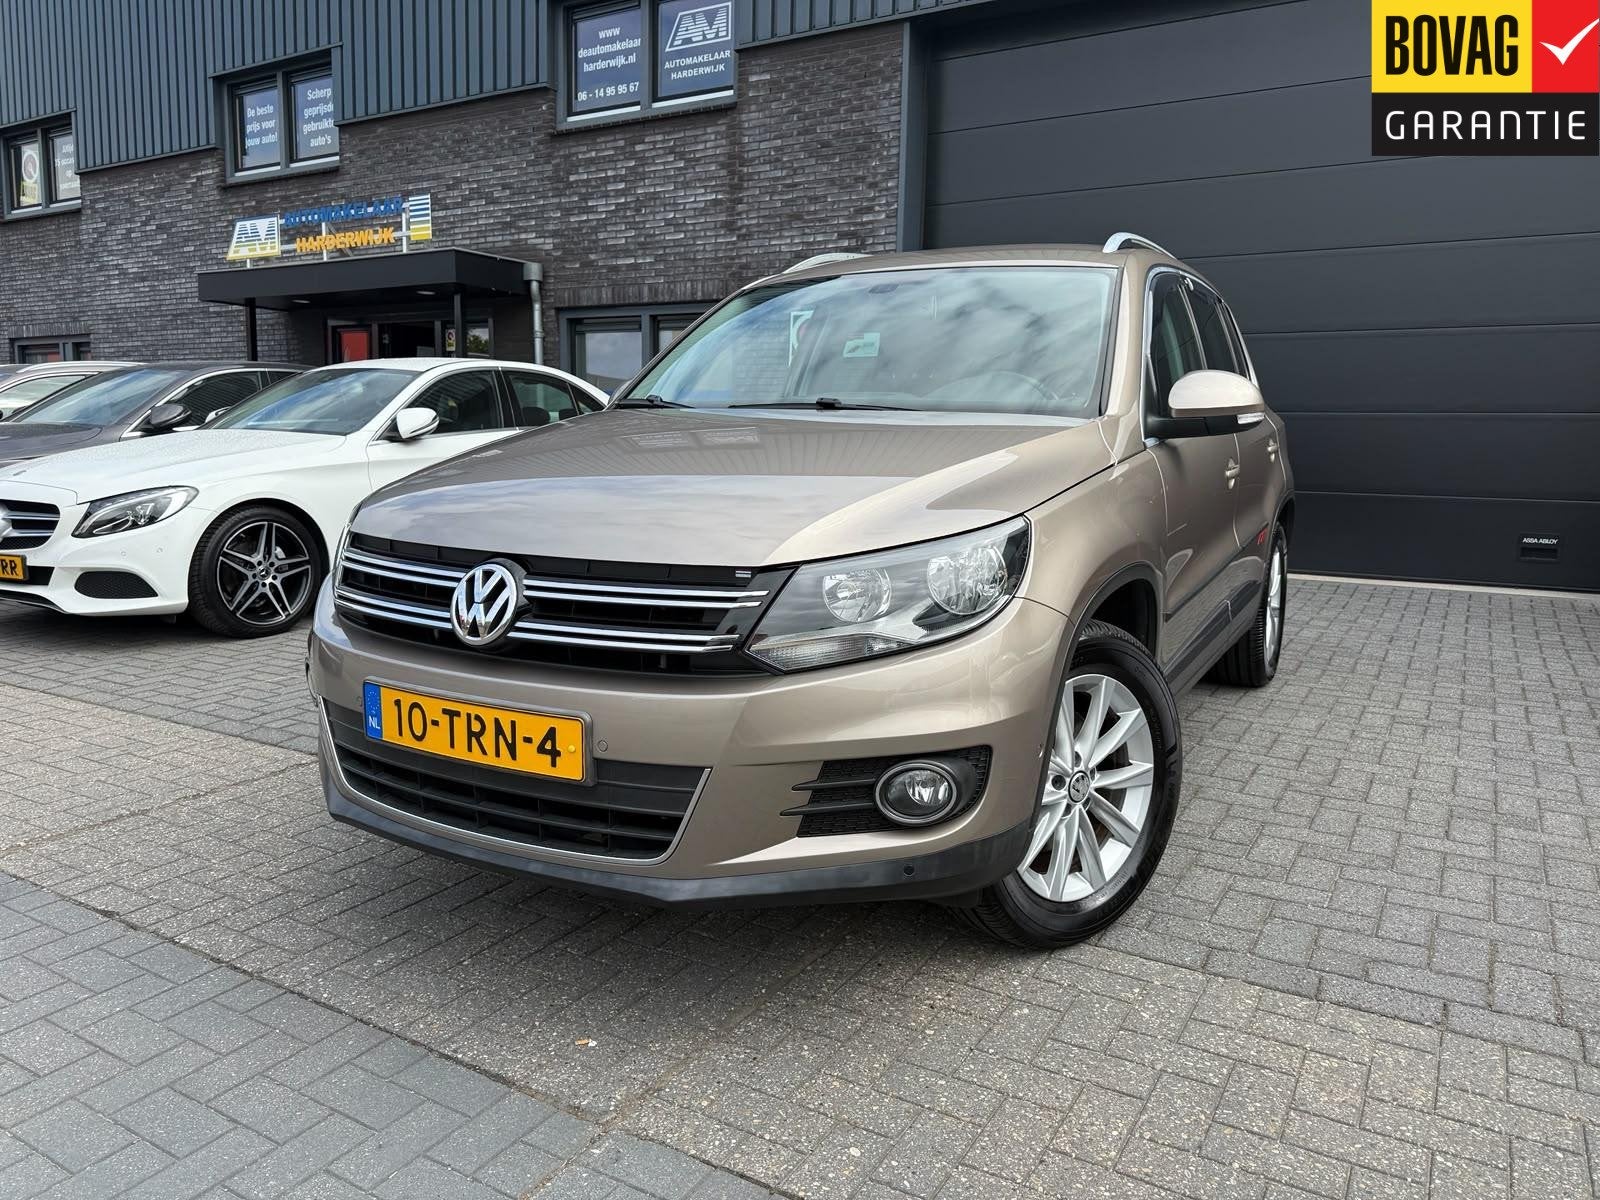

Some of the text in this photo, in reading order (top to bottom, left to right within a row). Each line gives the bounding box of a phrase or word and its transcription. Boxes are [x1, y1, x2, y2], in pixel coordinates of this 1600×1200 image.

[598, 26, 621, 39] www
[577, 38, 641, 58] deautomakelaar
[583, 52, 636, 73] harderwijk.nl
[664, 50, 731, 70] AUTOMAKELAAR
[671, 63, 726, 81] HARDERWIJK
[307, 88, 331, 100] Scherp
[577, 91, 588, 102] 06
[594, 87, 604, 98] 14
[605, 86, 616, 97] 95
[617, 84, 628, 95] 95
[629, 81, 640, 93] 67
[247, 104, 273, 118] De beste
[246, 119, 276, 134] prijs voor
[261, 132, 278, 144] auto!
[310, 134, 332, 147] auto's
[284, 195, 404, 228] AUTOMAKELAAR
[295, 226, 396, 252] HARDERWIJK
[368, 715, 381, 730] NL
[393, 698, 562, 768] 10-TRN-4
